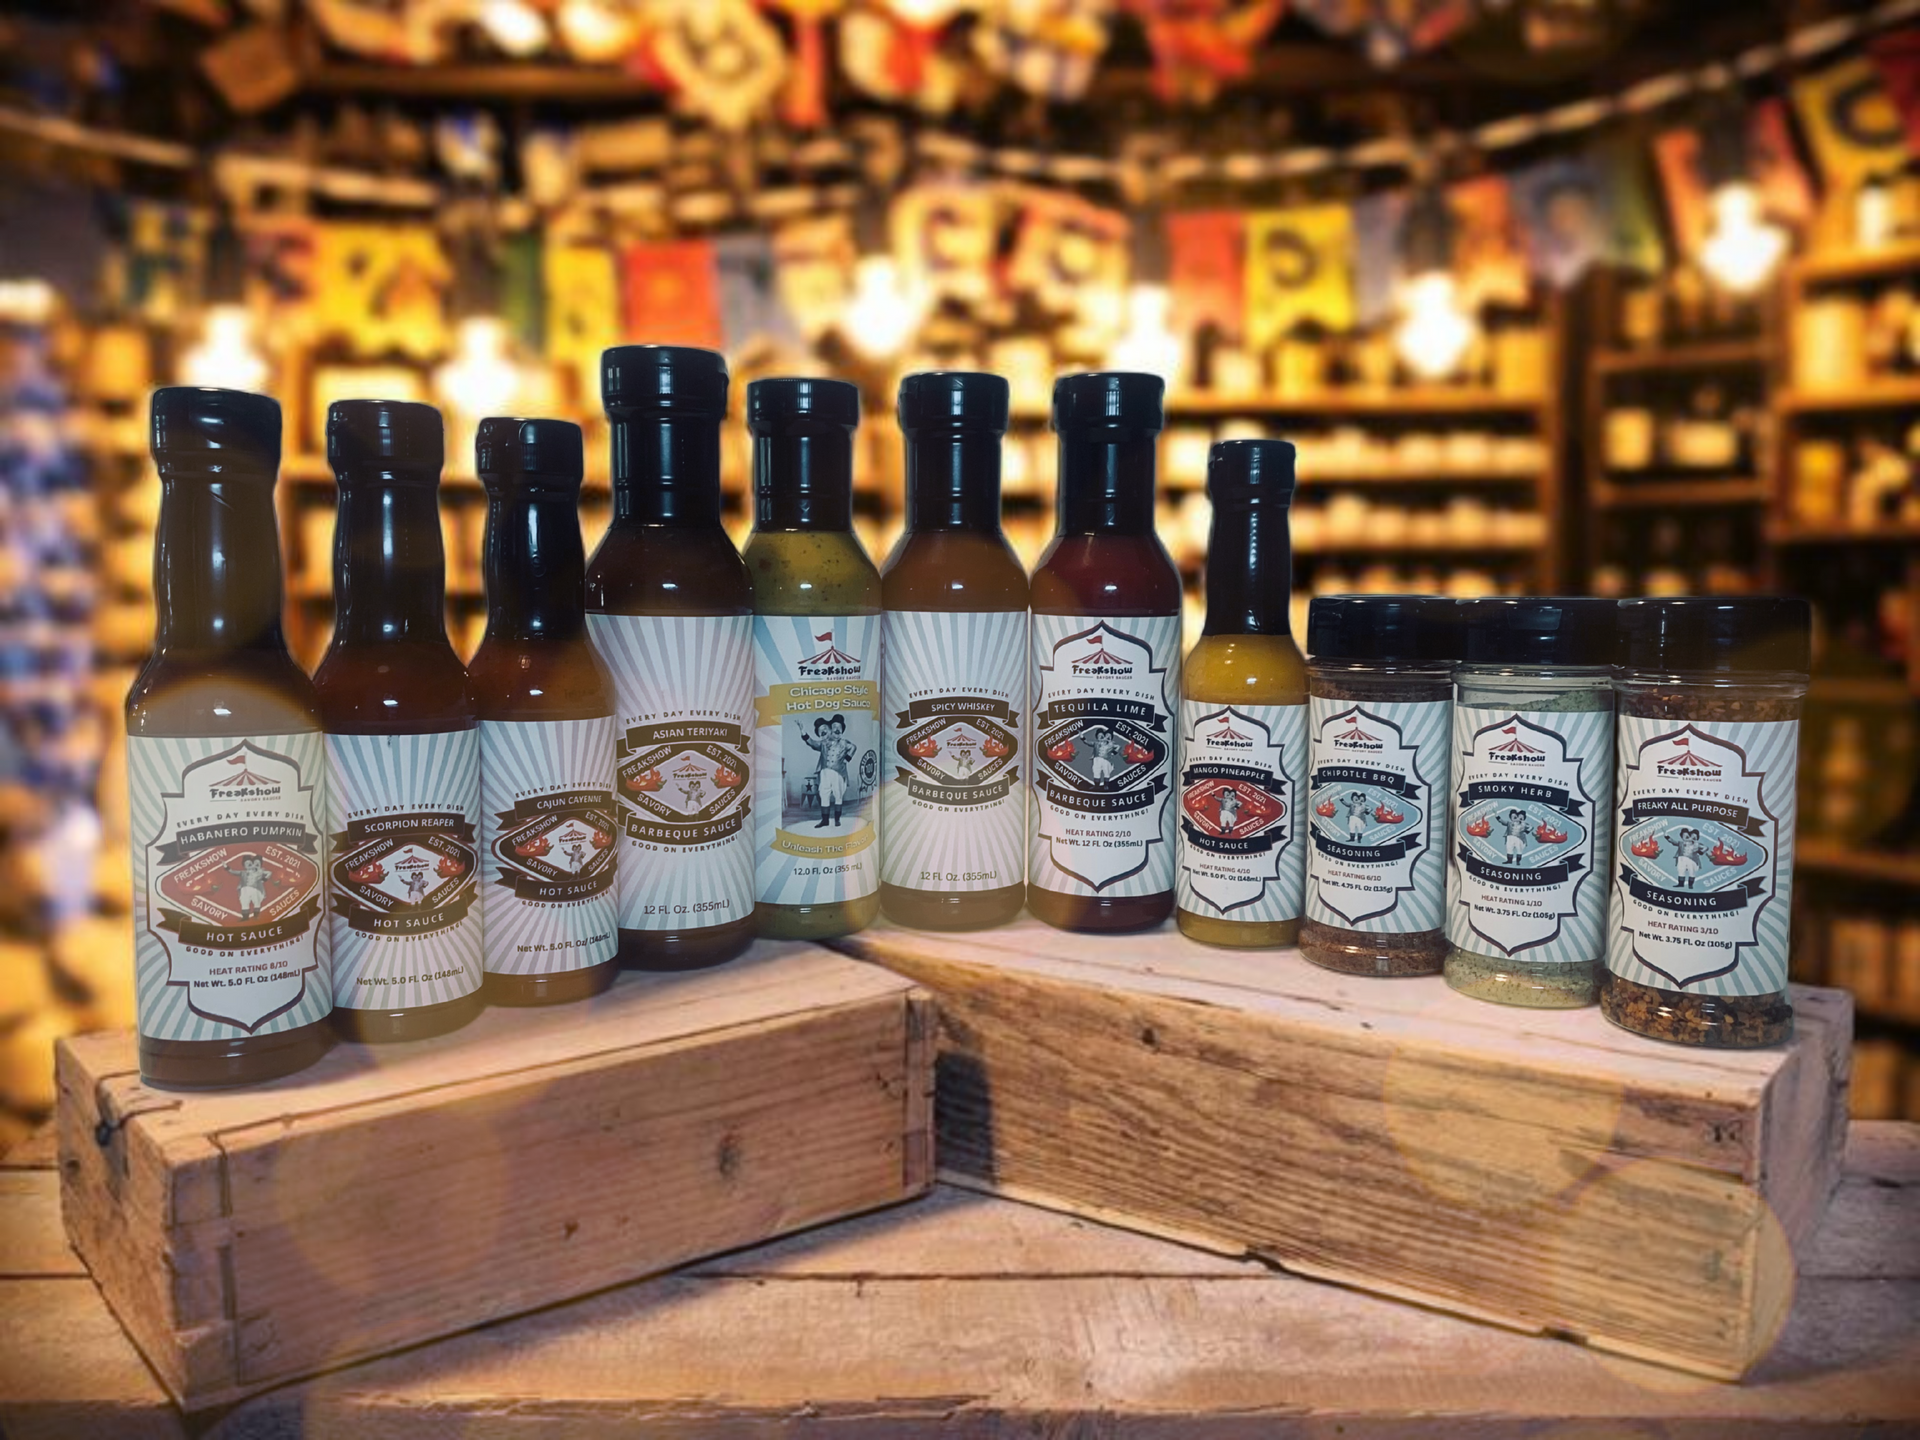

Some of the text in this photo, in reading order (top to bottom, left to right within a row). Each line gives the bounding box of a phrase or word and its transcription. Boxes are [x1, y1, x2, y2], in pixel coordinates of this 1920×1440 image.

[798, 665, 861, 676] Freakshow
[1071, 665, 1133, 675] Freakshow
[790, 684, 868, 697] Chicago Style
[1048, 689, 1071, 698] EVERY
[1135, 691, 1155, 700] DISH
[786, 698, 870, 711] Hot Dog Sauce
[931, 702, 995, 712] SPICY WHISKEY
[1054, 702, 1146, 716] TEQUILA LIME
[626, 709, 741, 724] EVERY DAY EVERY DISH
[653, 727, 727, 740] ASIAN TERIYAKI
[1044, 720, 1084, 747] FREAKSHOW
[1115, 721, 1149, 746] EST. 2021
[1334, 739, 1383, 749] Freakshow
[622, 746, 672, 778] FREAKSHOW
[706, 745, 737, 768] EST. 2021
[1489, 752, 1545, 762] Freakshow
[1054, 762, 1082, 785] SAVORY
[1117, 765, 1146, 787] SAUCES
[1220, 767, 1265, 780] PINEAPPLE
[1322, 770, 1394, 784] CHIPOTLE BBQ
[1657, 765, 1721, 777] Freakshow
[209, 786, 281, 799] Freakshow
[912, 785, 1003, 801] BARBEQUE SAUCE
[1049, 789, 1146, 808] BARBEQUE SAUCE
[1478, 785, 1552, 798] SMOKY HERB
[1633, 788, 1656, 796] EVERY
[1686, 789, 1718, 797] EVERY
[1725, 794, 1748, 804] DISH
[536, 795, 602, 809] CAJUN CAYENNE
[637, 793, 672, 816] SAVORY
[709, 789, 735, 814] SAUCES
[1637, 801, 1738, 817] FREAKY ALL PURPOSE
[1050, 805, 1070, 816] GOOD
[1091, 809, 1148, 821] EVERYTHING!
[365, 818, 454, 833] SCORPION REAPER
[631, 818, 736, 840] BARBEQUE SAUCE
[180, 826, 302, 844] HABANERO PUMPKIN
[1115, 830, 1131, 838] 2/10
[1199, 837, 1215, 847] HOT
[428, 836, 460, 858] EST. 2021
[631, 840, 658, 852] GOOD
[682, 835, 738, 853] EVERYTHING!
[782, 839, 823, 853] Unleash
[825, 845, 843, 853] The
[1114, 840, 1143, 848] (355mL)
[1327, 844, 1380, 857] SEASONING
[265, 846, 301, 868] EST. 2021
[345, 838, 394, 870] FREAKSHOW
[174, 848, 227, 884] FREAKSHOW
[793, 867, 810, 875] 12.0
[823, 866, 833, 874] Oz
[1480, 866, 1542, 880] SEASONING
[920, 871, 930, 879] 12
[962, 870, 997, 881] (355mL)
[359, 885, 394, 907] SAVORY
[432, 877, 459, 903] SAUCES
[539, 880, 598, 896] HOT SAUCE
[270, 889, 299, 916] SAUCES
[1481, 894, 1498, 903] HEAT
[1499, 897, 1525, 905] RATING
[1646, 890, 1716, 906] SEASONING
[191, 897, 227, 920] SAVORY
[644, 905, 655, 914] 12
[673, 905, 690, 914] Oz.
[693, 899, 730, 913] (355mL)
[1633, 899, 1739, 919] GOOD ON EVERYTHING!
[374, 912, 444, 928] HOT SAUCE
[1647, 920, 1667, 929] HEAT
[1668, 924, 1699, 933] RATING
[207, 926, 283, 942] HOT SAUCE
[1638, 931, 1650, 939] Net
[1652, 934, 1664, 942] Wt.
[1665, 936, 1681, 944] 3.75
[1694, 939, 1705, 947] Oz
[1707, 940, 1732, 949] (105g)
[186, 946, 213, 957] GOOD
[240, 935, 304, 957] EVERYTHING!
[209, 960, 288, 976] HEAT RATING 8/10
[356, 977, 372, 985] Net
[391, 976, 406, 985] 5.0
[421, 974, 433, 982] Oz
[434, 966, 464, 980] (148mL)
[194, 980, 209, 988] Net
[211, 979, 226, 988] Wt.
[228, 978, 243, 986] 5.0
[270, 968, 300, 981] (148mL)
